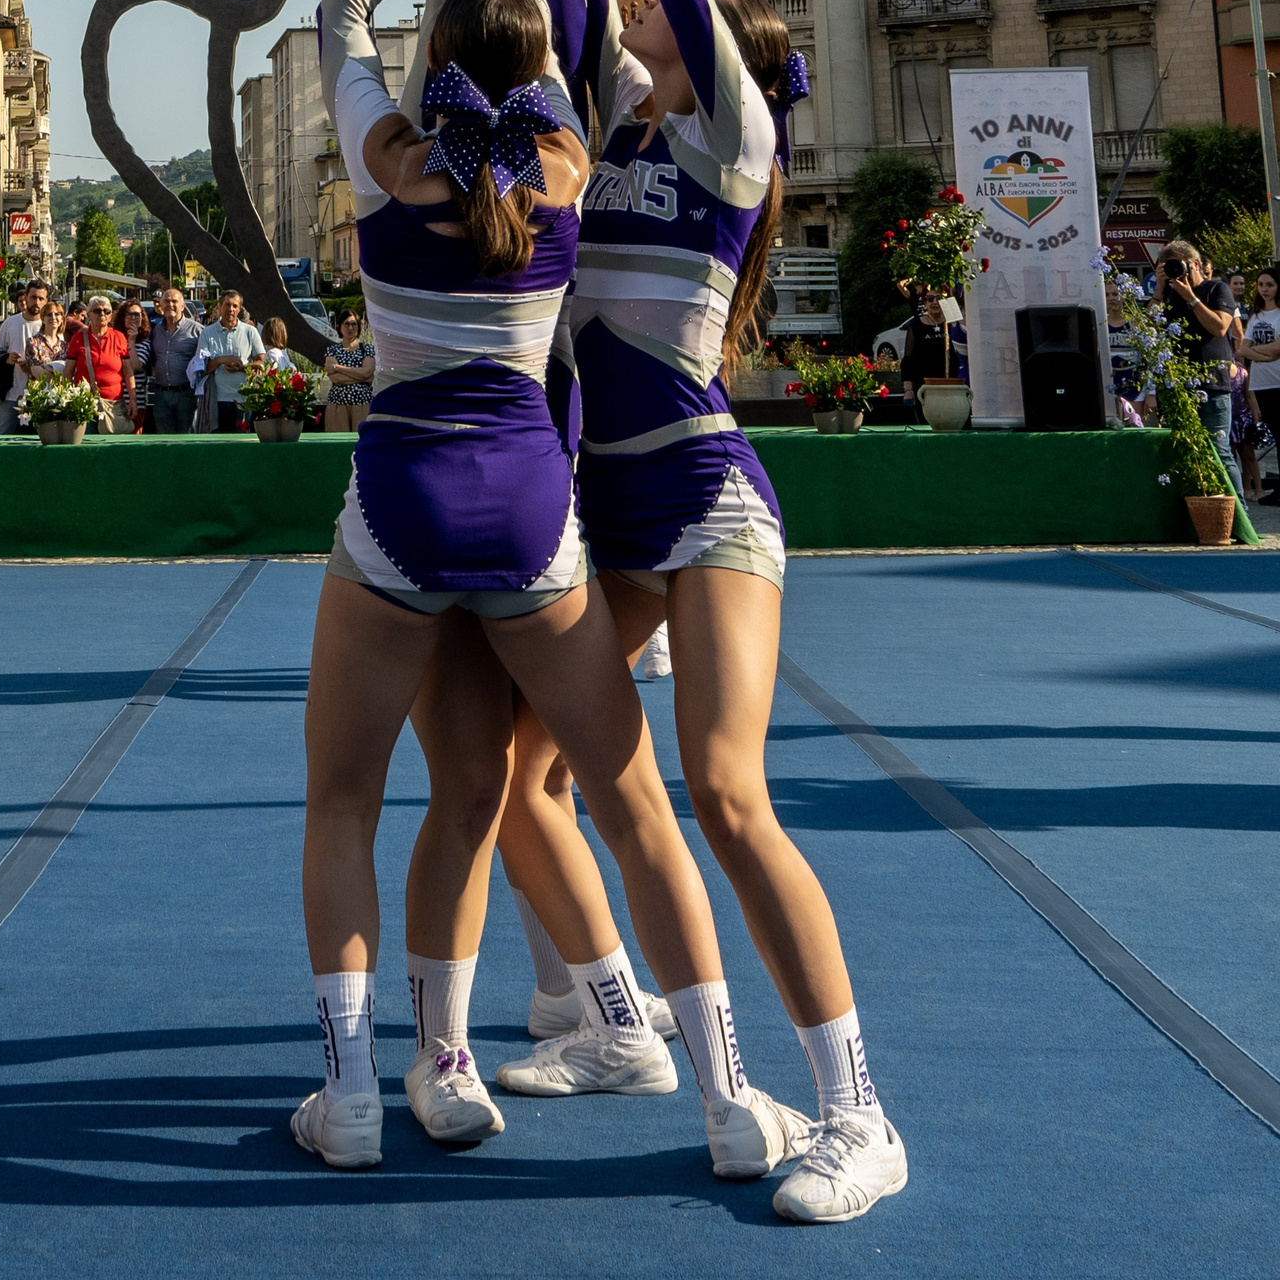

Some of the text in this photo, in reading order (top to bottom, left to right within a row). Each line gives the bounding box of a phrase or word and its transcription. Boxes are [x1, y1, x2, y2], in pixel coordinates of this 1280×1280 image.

[969, 114, 1074, 143] 10 ANNI
[1017, 136, 1031, 148] di
[583, 158, 678, 221] TANS
[976, 183, 1005, 196] ALBA
[13, 217, 30, 233] illy
[1105, 229, 1166, 239] RESTAURANT
[982, 226, 1022, 251] 2013
[1037, 223, 1079, 252] 2023
[599, 973, 635, 1027] TITAS
